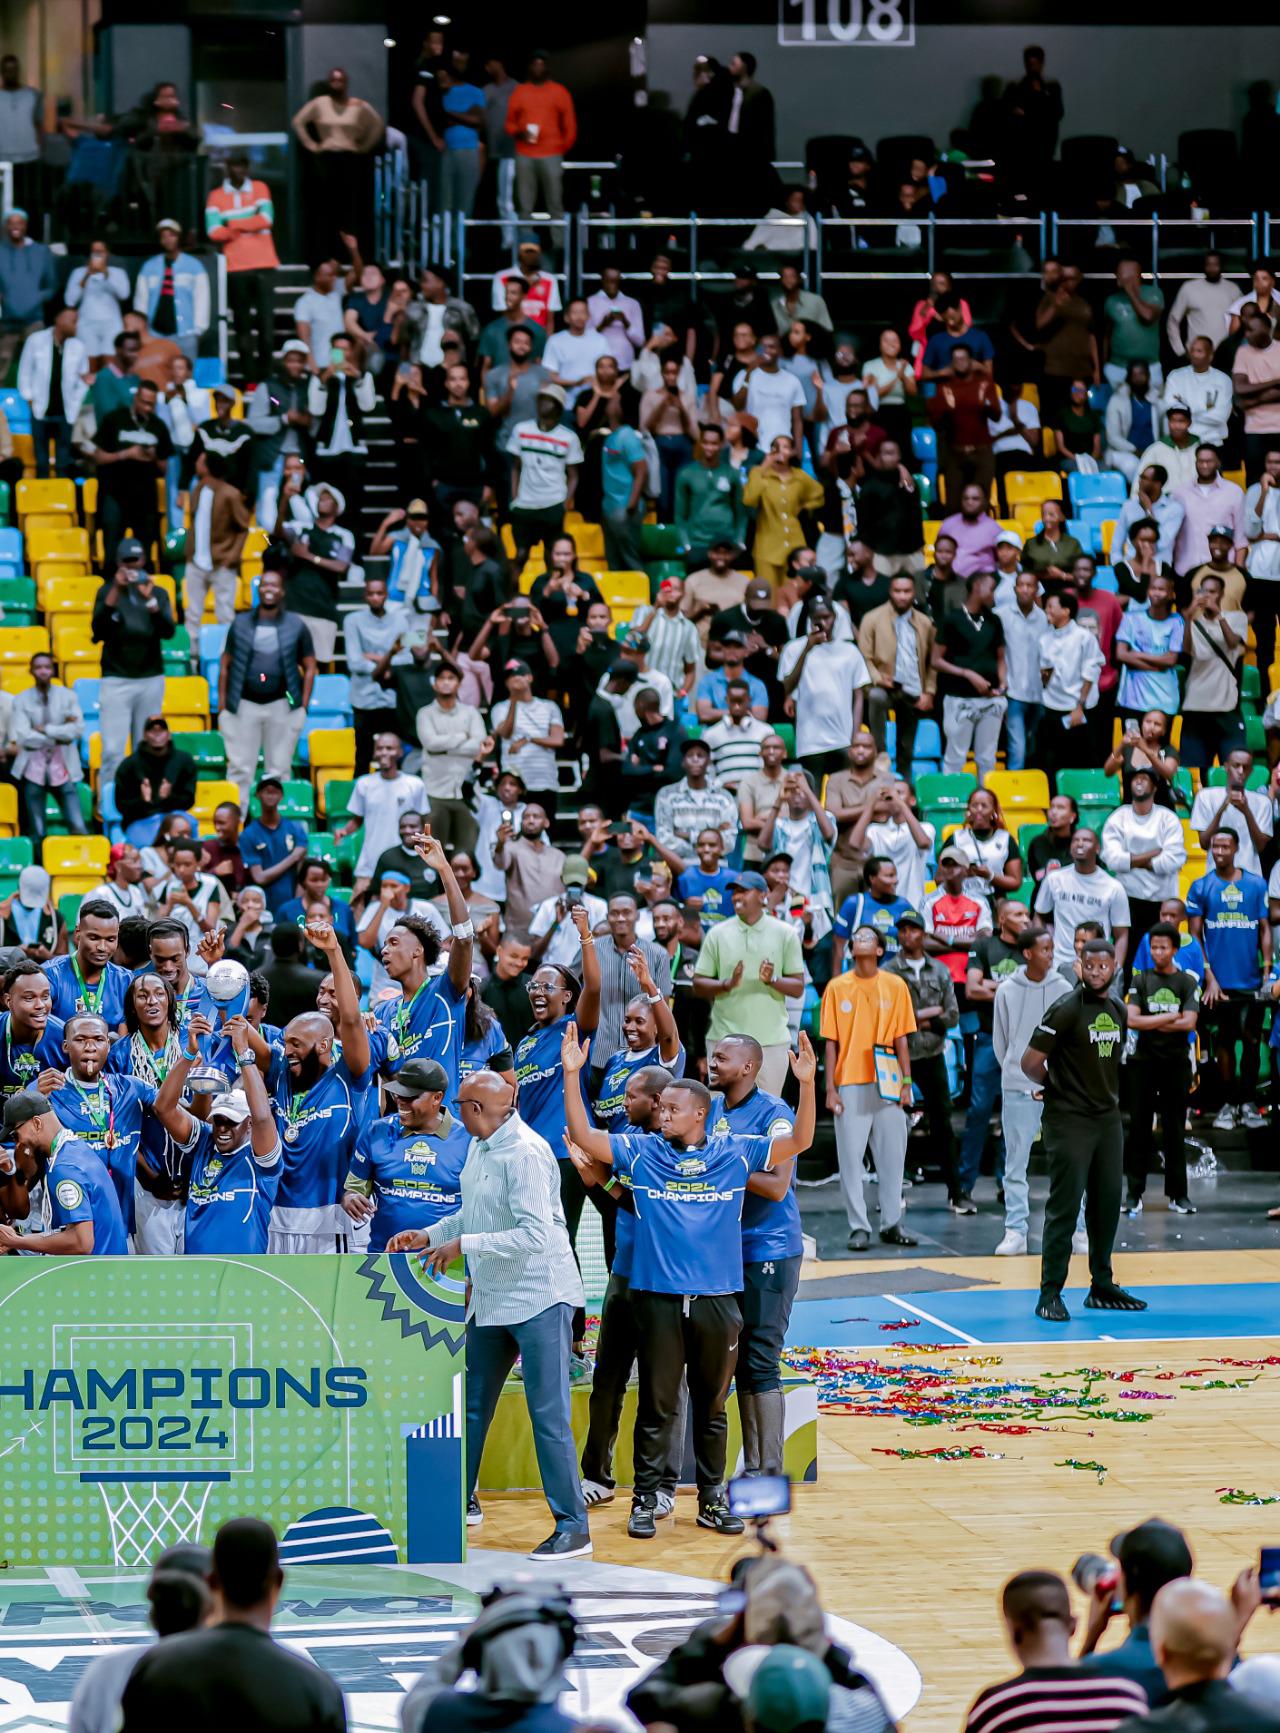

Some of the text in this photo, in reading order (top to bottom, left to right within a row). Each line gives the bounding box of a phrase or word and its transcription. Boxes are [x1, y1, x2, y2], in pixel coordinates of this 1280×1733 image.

[789, 0, 904, 40] 108
[403, 1153, 437, 1166] PLAYOFFS
[392, 1178, 442, 1192] 2024
[665, 1181, 716, 1193] 2024
[380, 1186, 456, 1203] CHAMPIONS
[647, 1188, 734, 1203] CHAMPIONS
[82, 1416, 229, 1450] 2024
